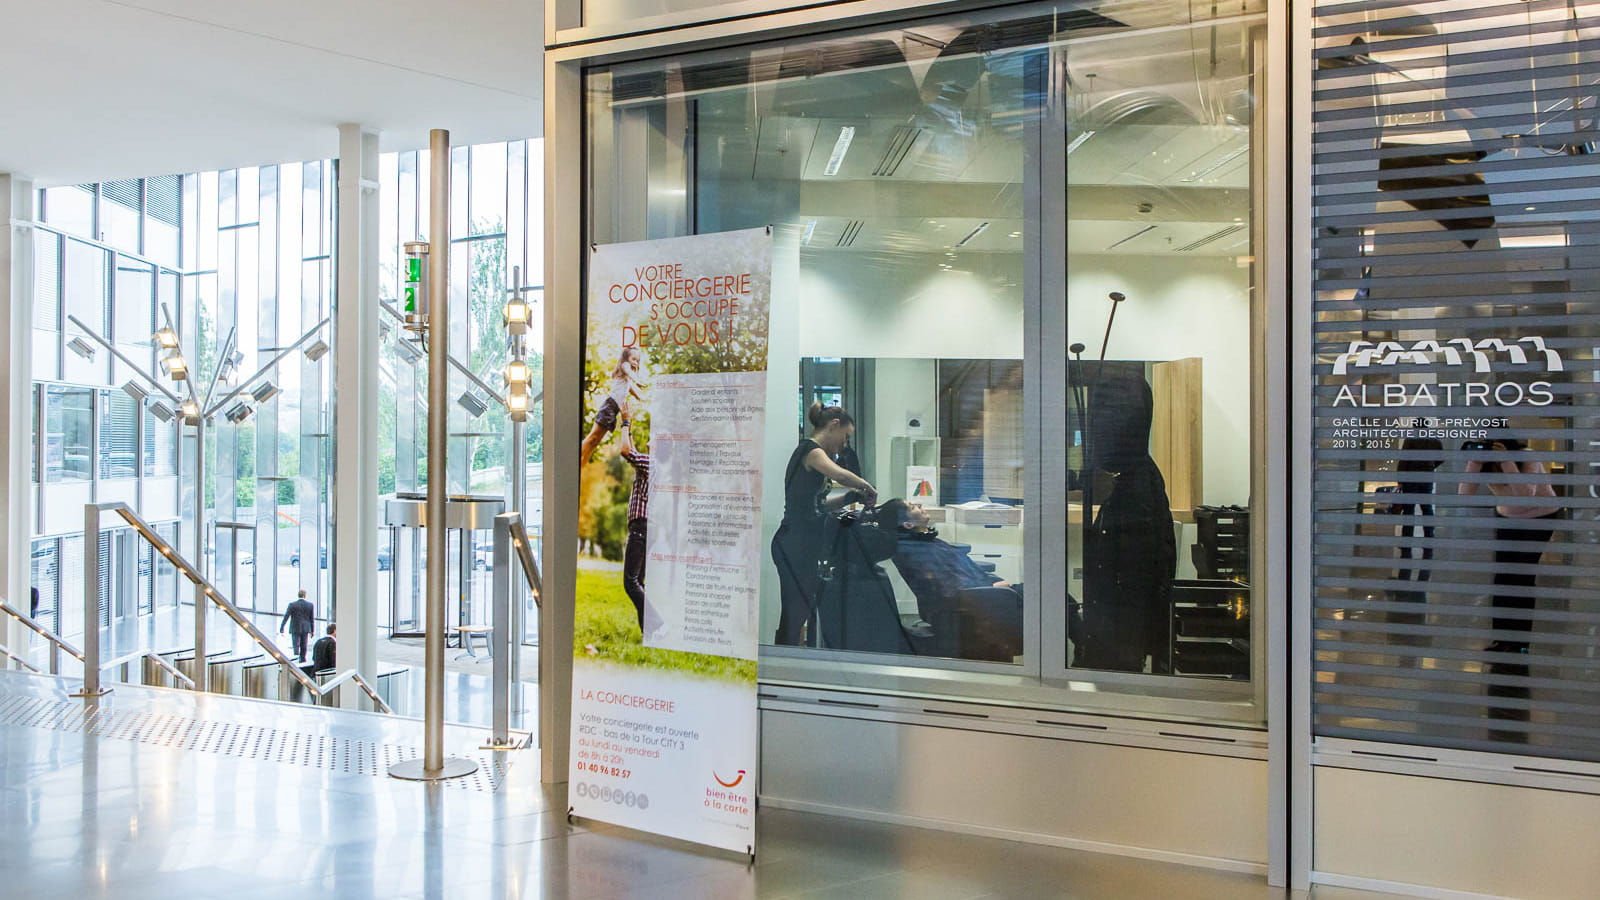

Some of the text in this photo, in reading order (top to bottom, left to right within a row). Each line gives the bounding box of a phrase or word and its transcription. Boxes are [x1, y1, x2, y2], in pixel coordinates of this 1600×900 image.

[635, 264, 682, 281] VOTRE
[608, 274, 751, 303] CONCIERGERIE
[651, 298, 738, 320] S'OCCUPE
[622, 325, 649, 348] DE
[658, 321, 719, 346] VOUS
[1332, 381, 1554, 407] ALBATROS
[1332, 417, 1509, 428] GAËLLE LAURIOT-PRÉVOST
[1332, 429, 1488, 438] ARCHITECTE DESIGNER
[1333, 440, 1356, 449] 2013
[1366, 440, 1391, 449] 2015
[580, 690, 675, 712] LA CONCIERGERIE
[580, 713, 699, 740] Votre conciergerie est ouverte
[580, 725, 597, 735] RDC
[604, 728, 618, 738] bas
[620, 732, 630, 741] de
[632, 734, 640, 742] la
[642, 735, 658, 745] Tour
[660, 737, 678, 750] CITY
[680, 741, 684, 750] 3
[578, 750, 589, 759] de
[591, 752, 600, 760] 8h
[610, 755, 624, 764] 20h
[579, 738, 660, 758] du lundi au vendredi
[578, 762, 631, 779] 01 40 96 82 57
[706, 786, 747, 804] bien être
[704, 798, 748, 815] à la carte
